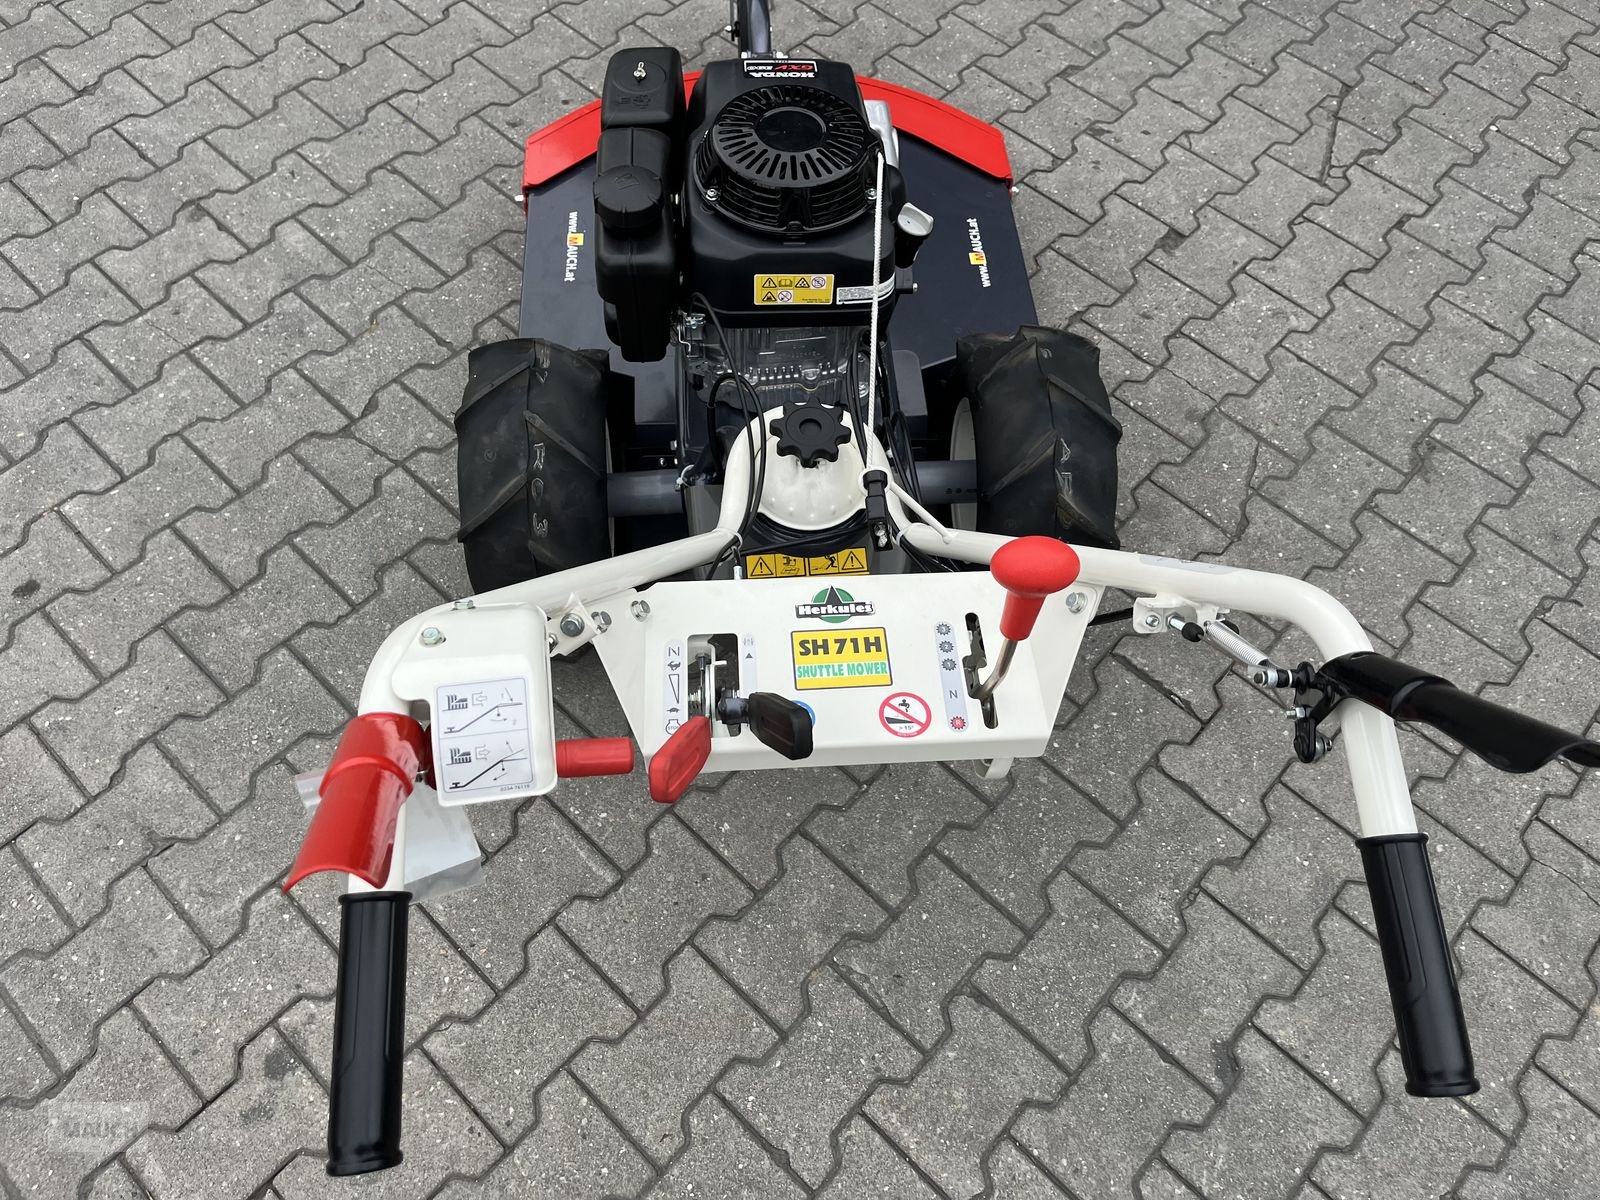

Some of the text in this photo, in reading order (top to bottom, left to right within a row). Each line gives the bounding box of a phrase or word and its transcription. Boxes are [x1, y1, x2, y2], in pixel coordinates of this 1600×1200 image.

[564, 211, 579, 282] www.MAUCH.at
[966, 218, 991, 288] www.MAUCH.at
[798, 603, 874, 615] Herkules
[798, 639, 830, 656] SH
[797, 661, 888, 678] SHUTTLE MOWER
[949, 689, 959, 699] N
